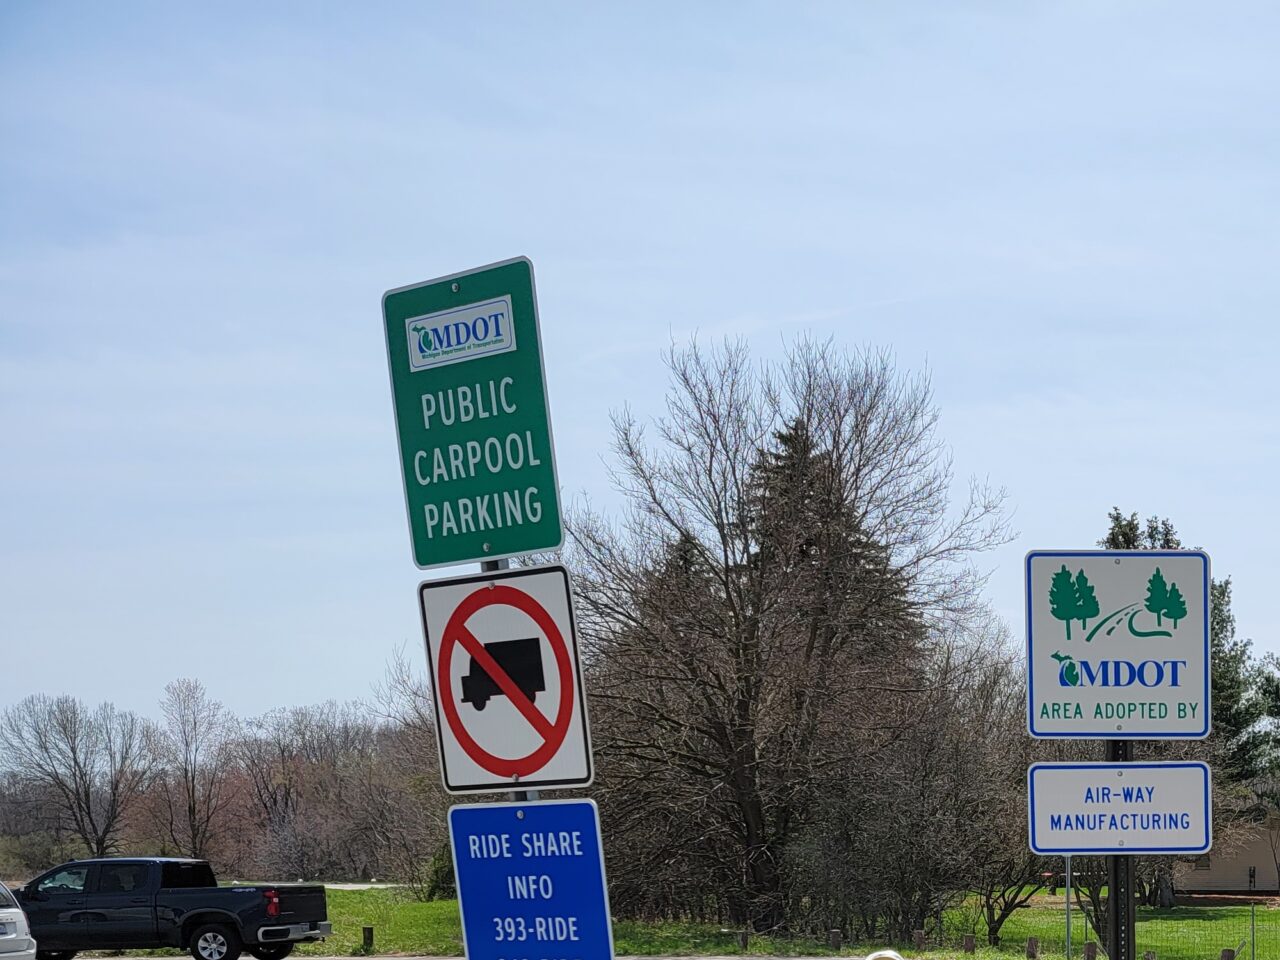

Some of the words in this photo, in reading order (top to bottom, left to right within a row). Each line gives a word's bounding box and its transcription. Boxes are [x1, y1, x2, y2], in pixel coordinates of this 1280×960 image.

[431, 313, 504, 351] MDOT
[421, 376, 517, 430] PUBLIC
[414, 430, 541, 486] CARPOOL
[424, 486, 542, 539] PARKING
[1078, 660, 1187, 688] MDOT
[1039, 702, 1083, 720] AREA
[1093, 702, 1169, 720] ADOPTED
[1177, 702, 1199, 720] BY
[1084, 786, 1155, 804] AIR-WAY
[1050, 812, 1190, 831] MANUFACTURING
[468, 834, 512, 859] RIDE
[521, 831, 583, 857] SHARE
[507, 874, 553, 900] INFO
[493, 916, 580, 942] 393-RIDE
